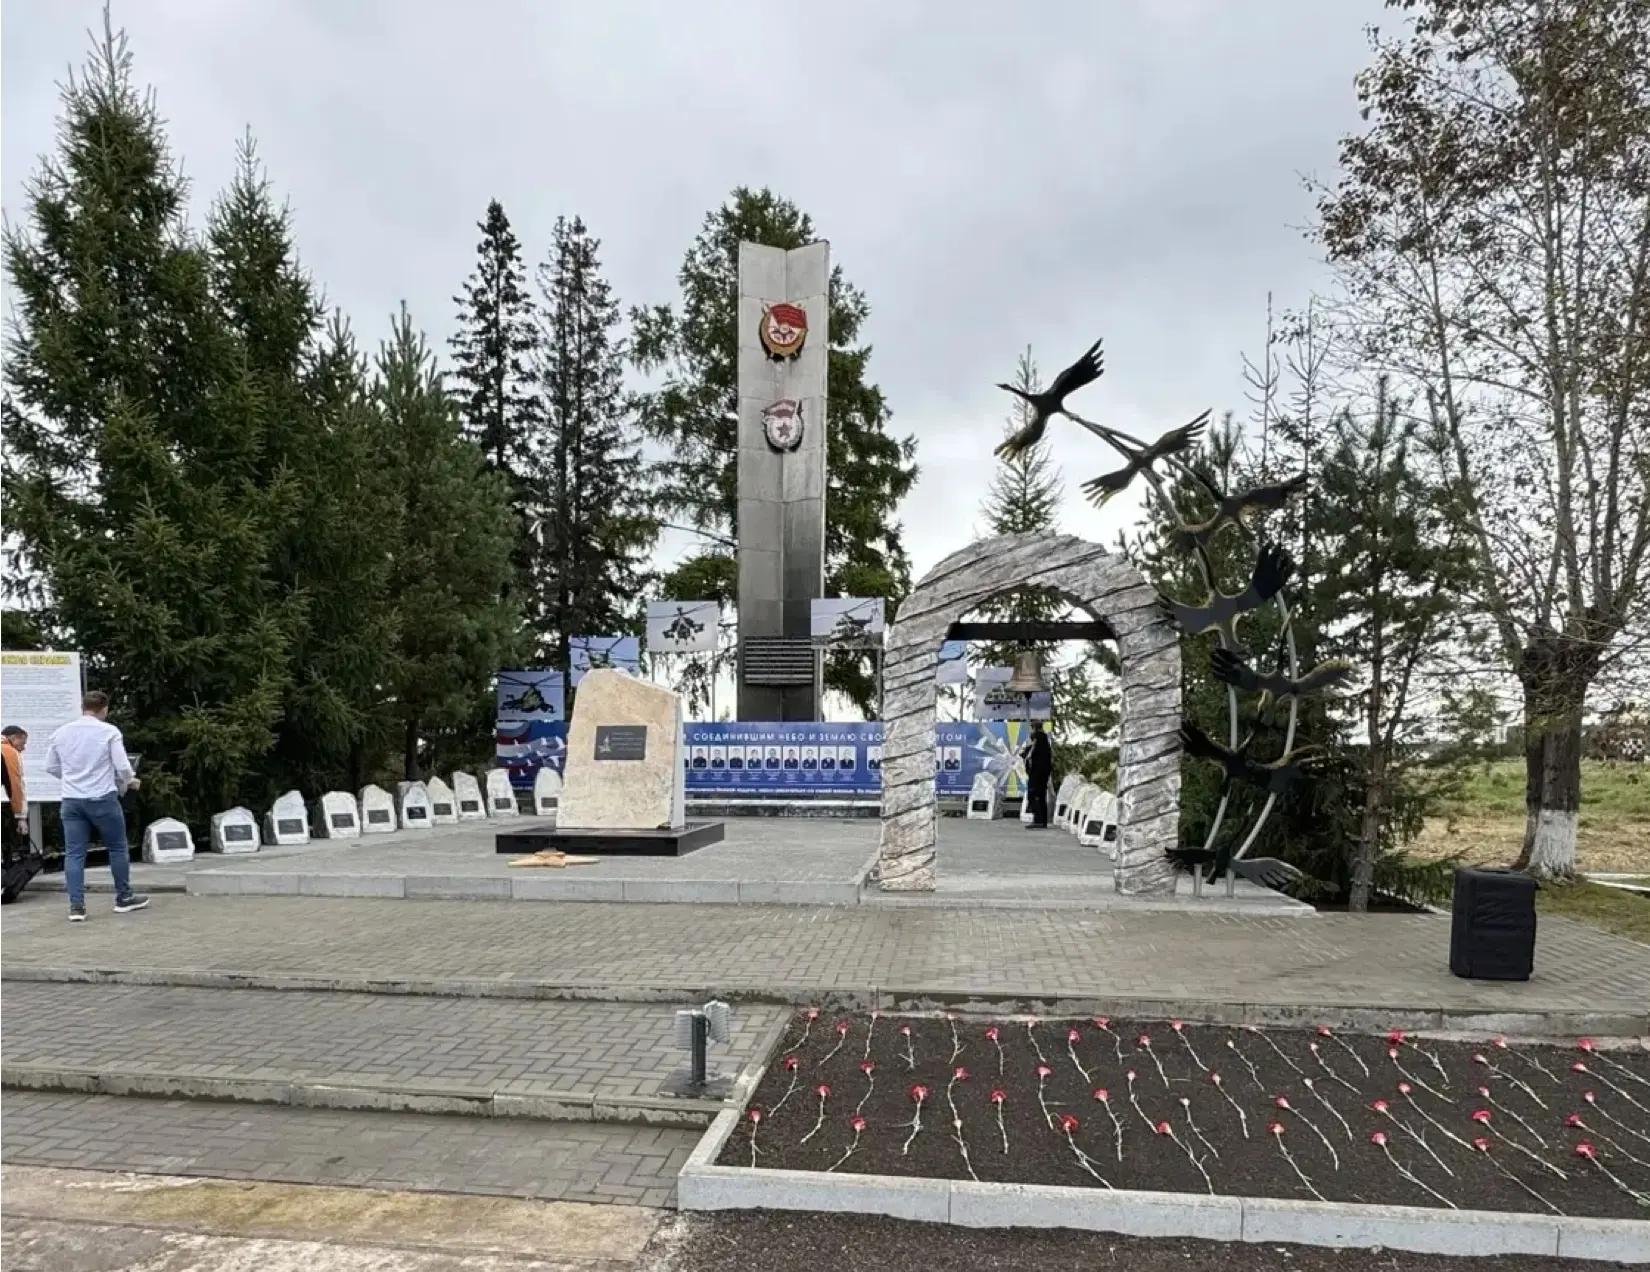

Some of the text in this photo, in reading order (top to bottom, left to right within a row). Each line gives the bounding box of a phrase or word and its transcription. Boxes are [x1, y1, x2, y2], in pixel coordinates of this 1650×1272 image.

[693, 732, 774, 742] СОЕДИНИВШИМ
[778, 732, 805, 742] НЕБО
[809, 732, 816, 741] И
[819, 732, 857, 742] ЗЕМЛЮ
